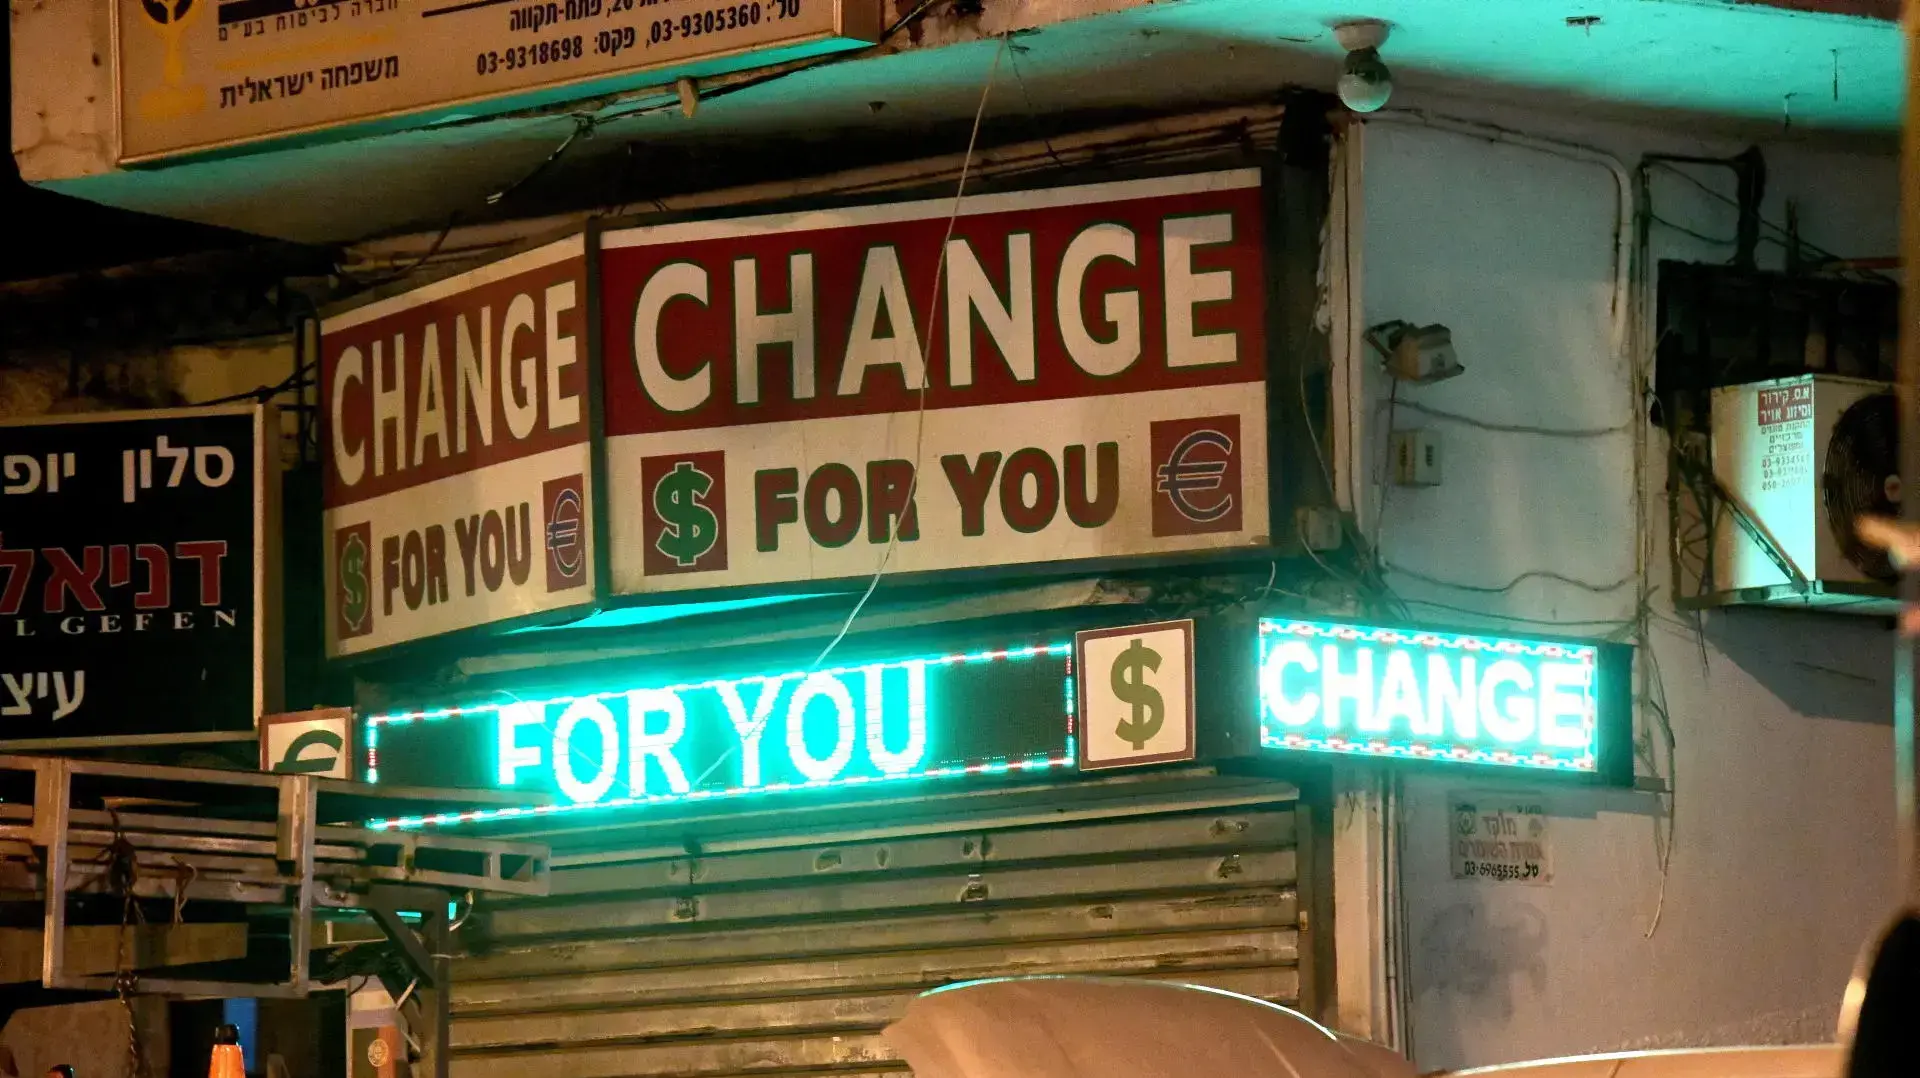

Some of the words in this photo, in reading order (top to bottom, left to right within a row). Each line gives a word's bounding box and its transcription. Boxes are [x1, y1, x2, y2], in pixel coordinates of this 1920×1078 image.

[276, 5, 340, 32] לביטוח
[476, 35, 583, 75] 03-9318698
[594, 27, 635, 56] פקס:
[219, 71, 313, 109] ישראלית
[321, 56, 399, 91] משפחה
[634, 212, 1238, 413] CHANGE
[332, 280, 580, 487] CHANGE
[121, 435, 235, 503] סלון
[754, 458, 921, 553] FOR
[940, 441, 1120, 538] YOU
[0, 530, 228, 616] דניאל
[382, 524, 449, 617] FOR
[454, 502, 532, 597] YOU
[60, 608, 237, 635] GEFEN
[497, 686, 693, 803] FOR
[718, 660, 928, 783] YOU
[1265, 640, 1588, 748] CHANGE
